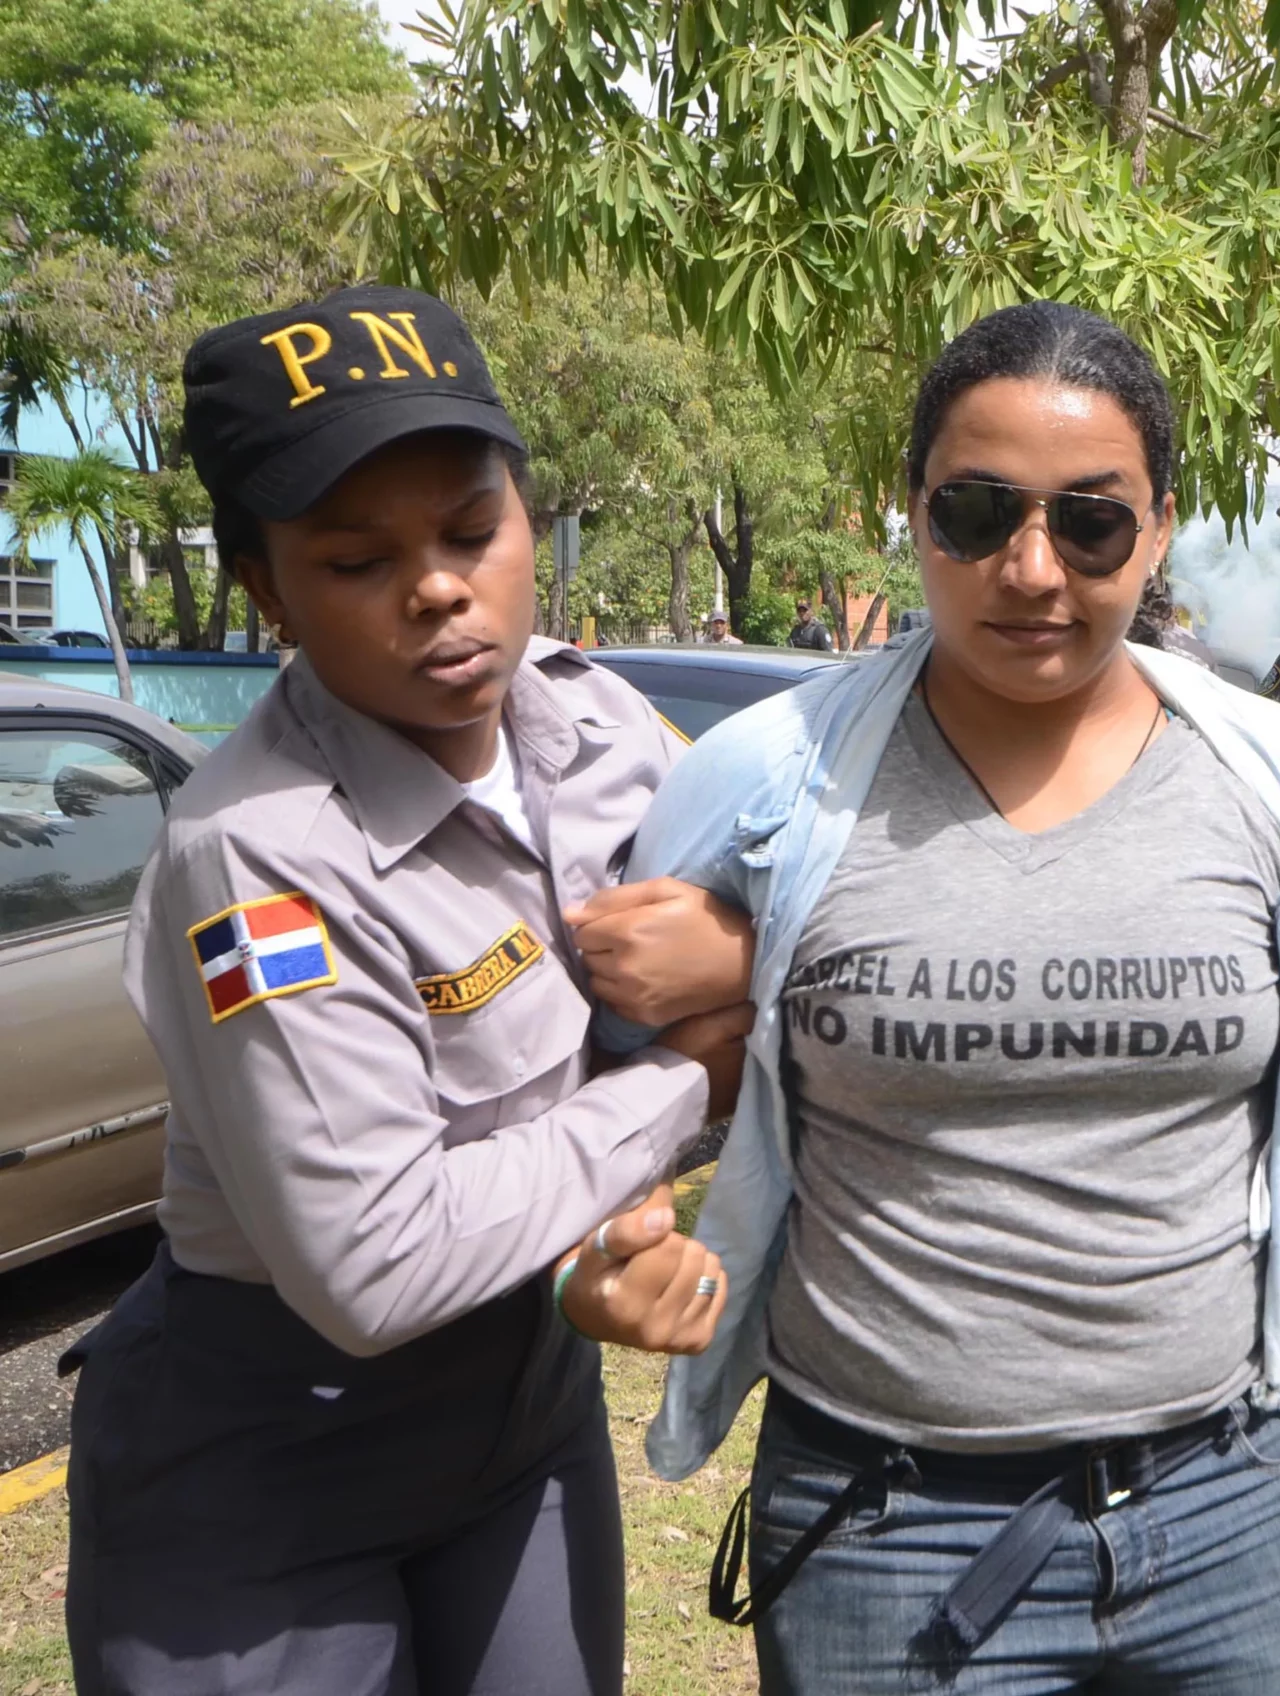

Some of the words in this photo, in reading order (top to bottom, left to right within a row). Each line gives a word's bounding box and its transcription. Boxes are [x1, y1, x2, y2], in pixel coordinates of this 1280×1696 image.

[259, 311, 459, 409] P.N.
[417, 947, 518, 1008] CABRERA
[907, 957, 932, 999] A
[946, 958, 1016, 1001] LOS
[1042, 954, 1245, 1001] CORRUPTOS
[791, 997, 848, 1047] NO
[872, 1015, 1245, 1062] IMPUNIDAD
